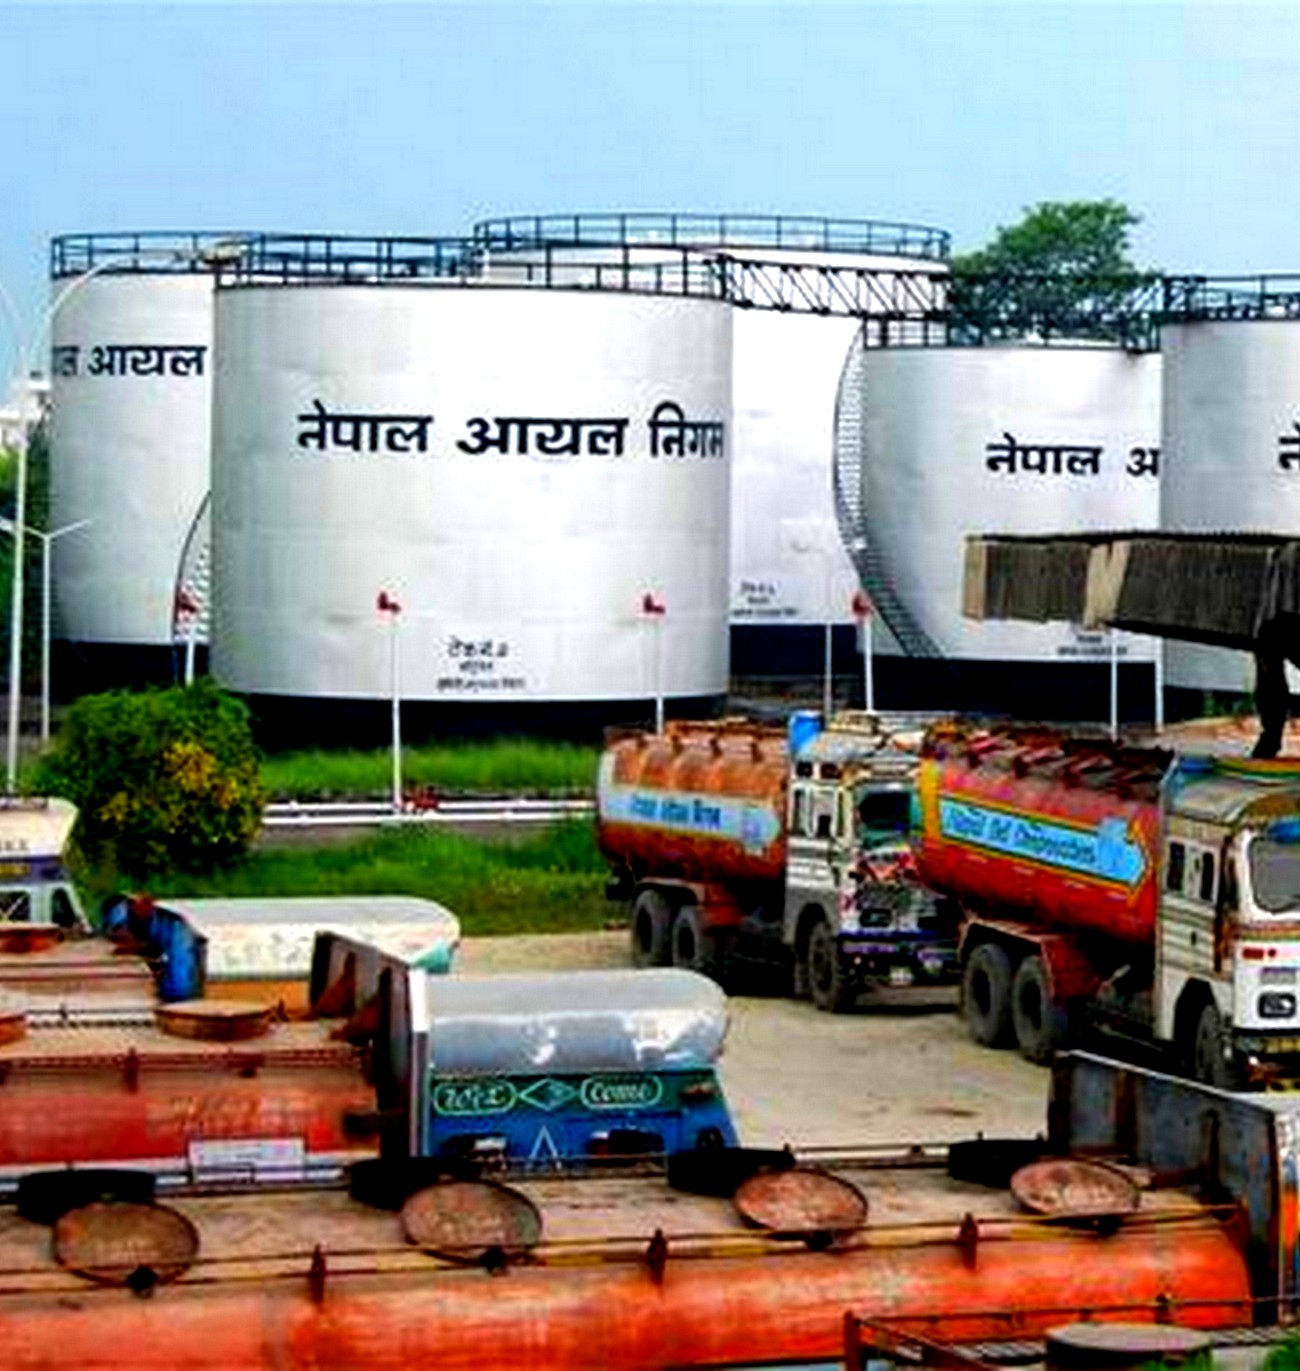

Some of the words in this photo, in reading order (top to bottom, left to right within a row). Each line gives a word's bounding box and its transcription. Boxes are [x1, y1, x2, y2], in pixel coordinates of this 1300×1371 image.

[87, 344, 208, 377] आयल
[297, 399, 434, 452] नेपाल
[456, 417, 629, 457] आयल
[647, 400, 725, 458] निगम
[986, 432, 1103, 475] नेपाल
